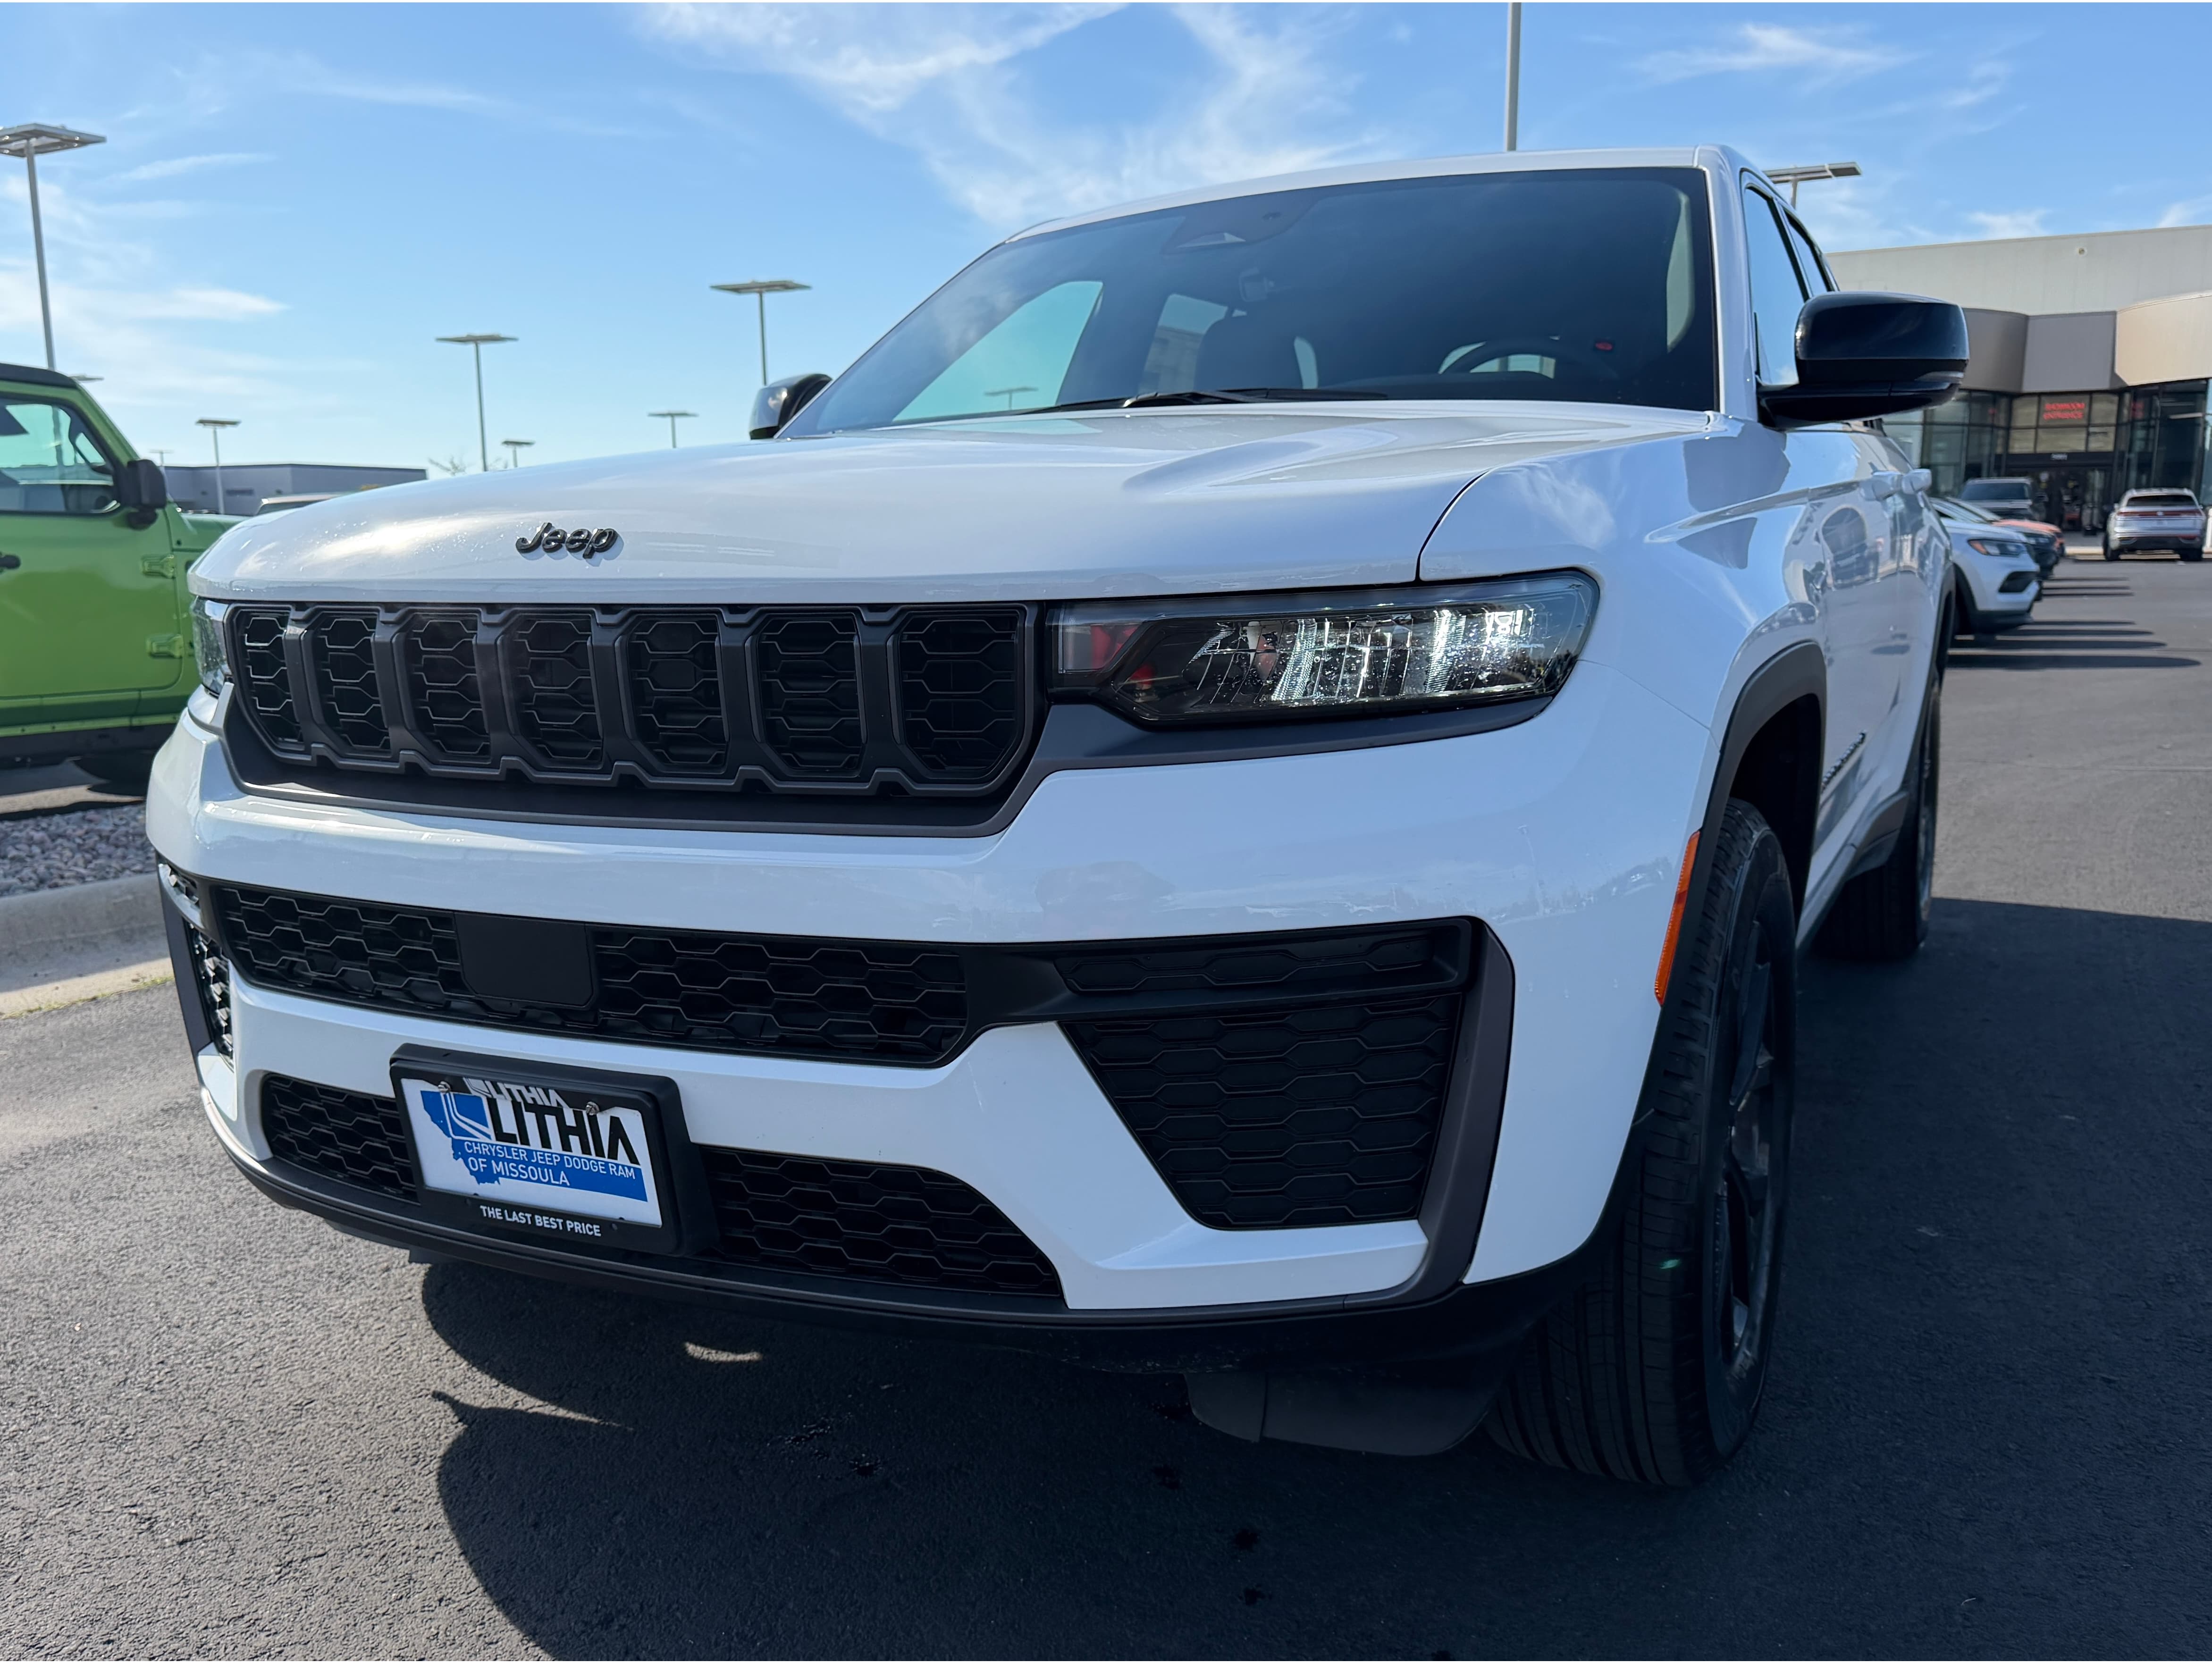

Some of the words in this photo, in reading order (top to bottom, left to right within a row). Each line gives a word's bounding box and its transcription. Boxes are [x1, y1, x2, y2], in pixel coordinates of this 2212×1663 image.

[515, 522, 618, 559] Jeep
[484, 1080, 570, 1109] LITHIA
[487, 1096, 641, 1166] LITHIA
[464, 1141, 528, 1162] CHRYSLER
[531, 1151, 561, 1166] JEEP
[564, 1156, 607, 1174] DODGE
[609, 1163, 636, 1180] RAM
[468, 1157, 487, 1172] OF
[491, 1160, 570, 1186] MISSOULA
[479, 1205, 504, 1220] THE
[505, 1209, 532, 1225] LAST
[535, 1214, 564, 1231] BEST
[566, 1219, 602, 1237] PRICE
